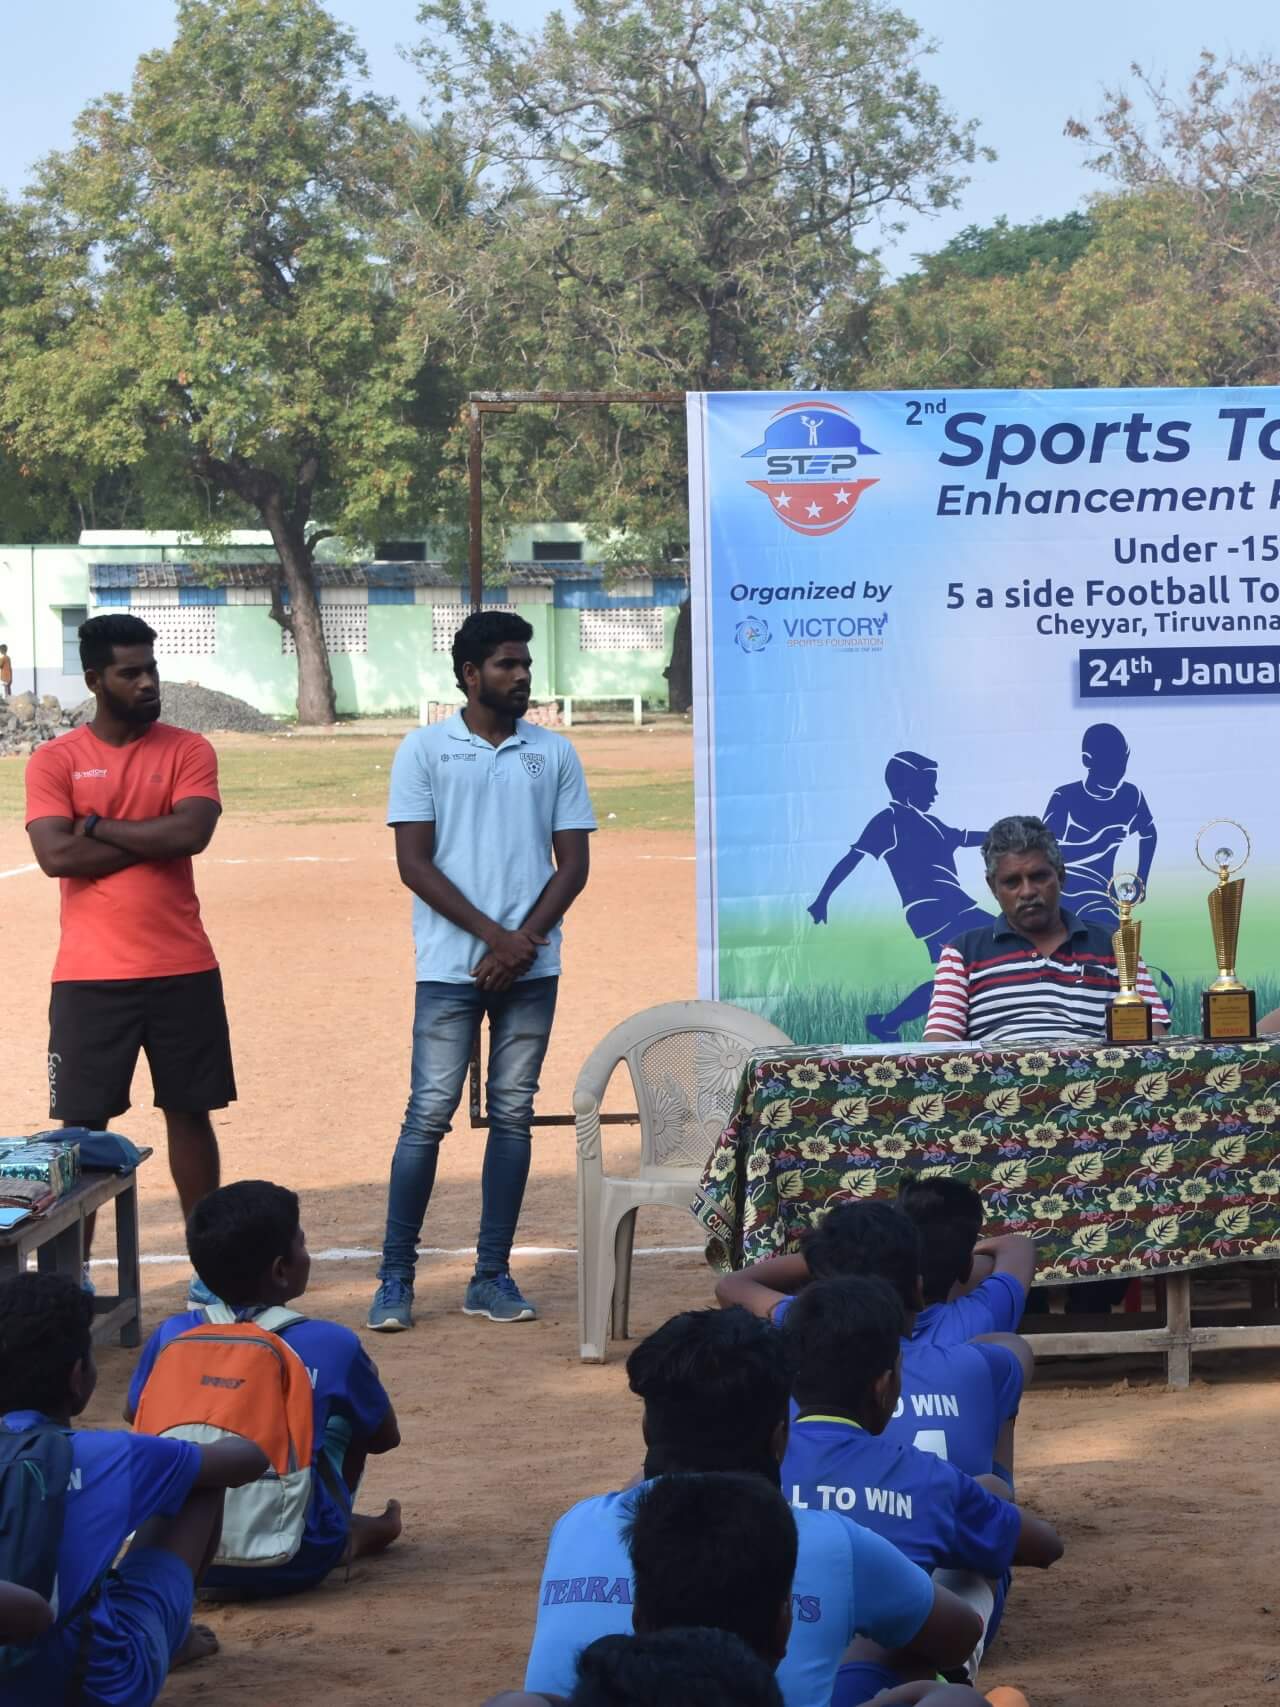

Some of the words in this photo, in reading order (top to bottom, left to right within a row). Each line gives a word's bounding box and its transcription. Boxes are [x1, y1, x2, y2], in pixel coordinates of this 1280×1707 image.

[905, 398, 947, 426] 2nd
[938, 411, 1193, 481] Sports
[766, 454, 857, 475] STEP
[936, 481, 1255, 516] Enhancement
[1114, 534, 1218, 564] Under
[730, 580, 857, 605] Organized
[863, 580, 893, 603] by
[946, 582, 965, 609] 5
[975, 588, 994, 609] a
[1005, 578, 1074, 608] side
[1086, 575, 1230, 607] Football
[783, 612, 888, 638] VICTORY
[1036, 612, 1148, 639] Cheyyar,
[787, 638, 824, 648] SPORTS
[825, 637, 884, 648] FOUNDATION
[910, 1393, 959, 1417] WIN
[816, 1485, 857, 1510] TO
[864, 1487, 913, 1520] WIN
